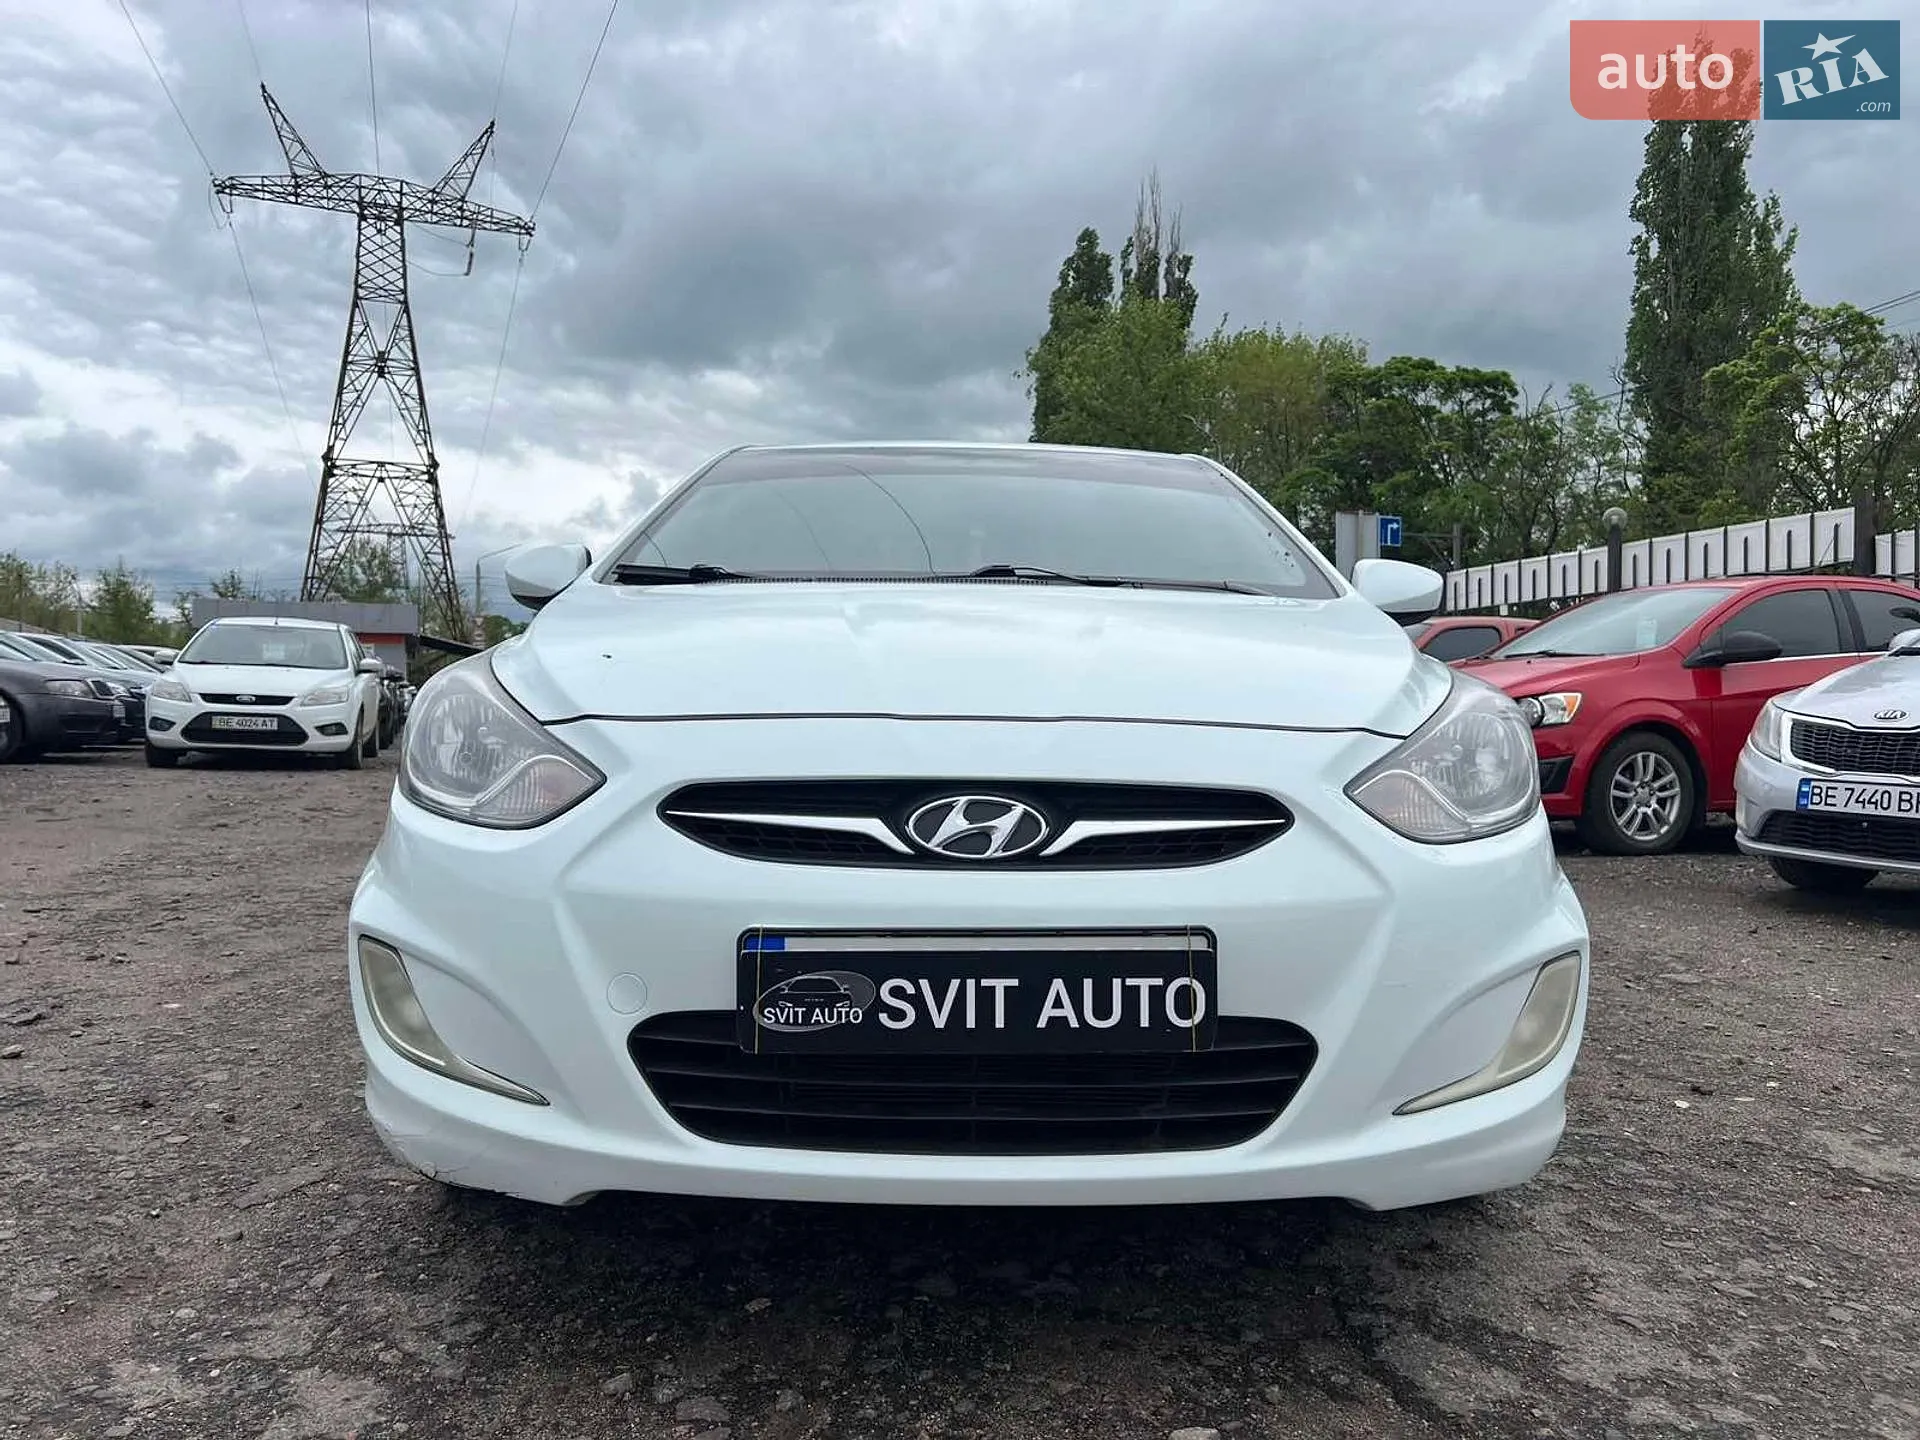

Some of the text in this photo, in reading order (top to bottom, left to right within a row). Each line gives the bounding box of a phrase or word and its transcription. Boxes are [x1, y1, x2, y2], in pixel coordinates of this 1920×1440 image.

[219, 718, 234, 727] BE
[261, 719, 275, 728] AT
[1810, 785, 1838, 807] BE
[1844, 787, 1892, 811] 7440
[878, 976, 1207, 1029] SVIT AUTO
[763, 1007, 862, 1023] SVIT AUTO
